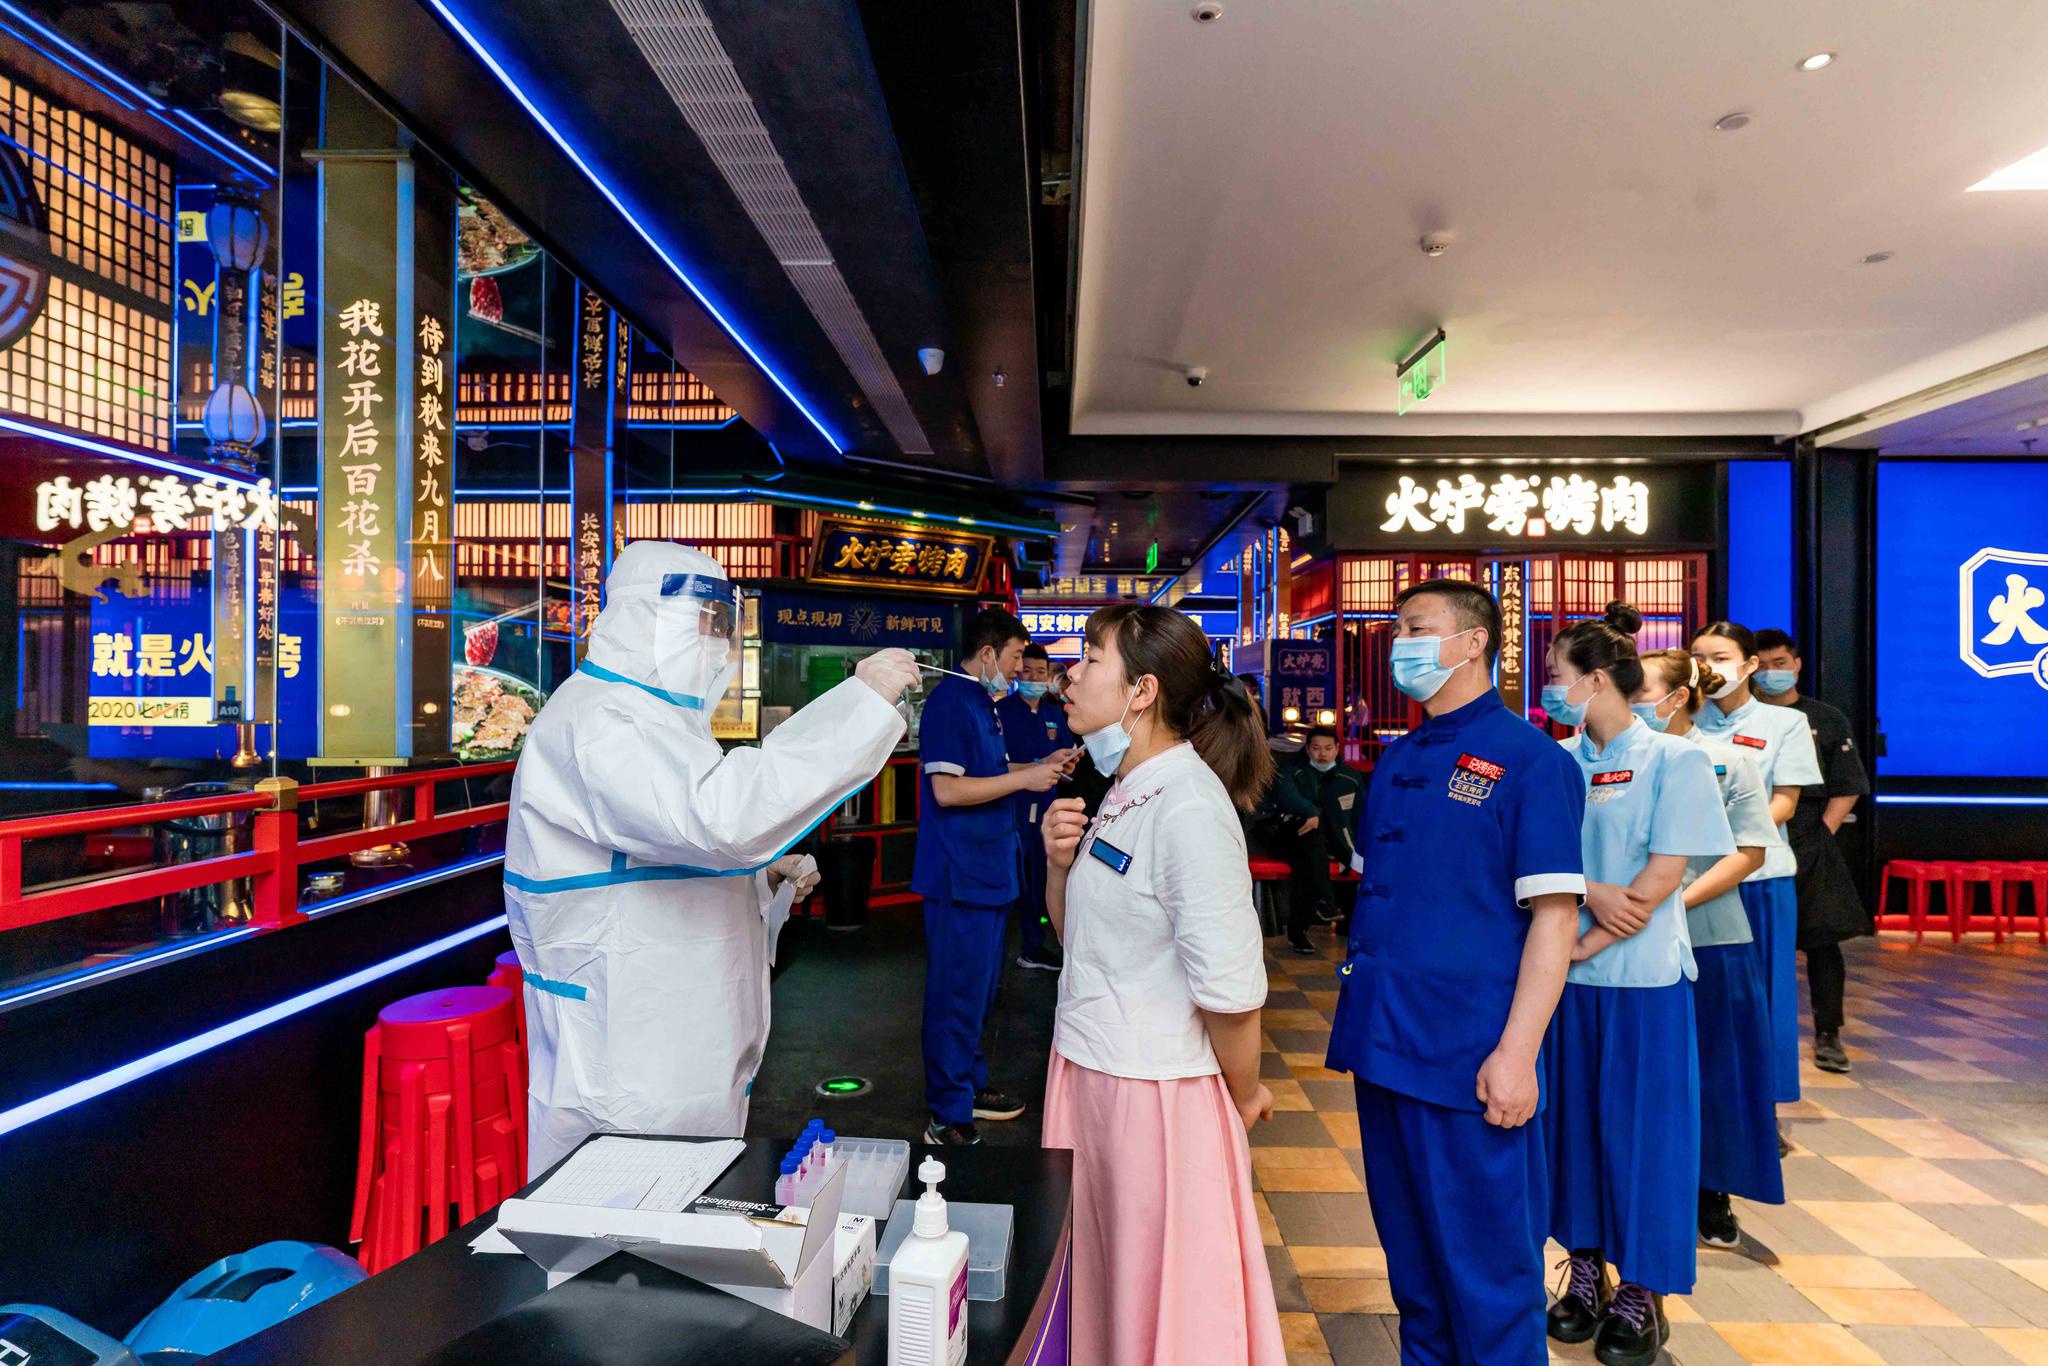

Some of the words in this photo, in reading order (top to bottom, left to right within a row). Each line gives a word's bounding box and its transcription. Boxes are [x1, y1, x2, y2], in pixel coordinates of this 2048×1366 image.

[337, 298, 383, 578] 我花开后百花杀
[417, 313, 446, 582] 待到秋来九月八
[1379, 473, 1649, 536] 火炉旁烤肉
[834, 536, 968, 580] 火炉旁烤肉
[886, 614, 944, 633] 新鲜可见
[1980, 573, 2048, 646] 火
[92, 632, 302, 679] 就是火旁
[219, 705, 239, 716] A10
